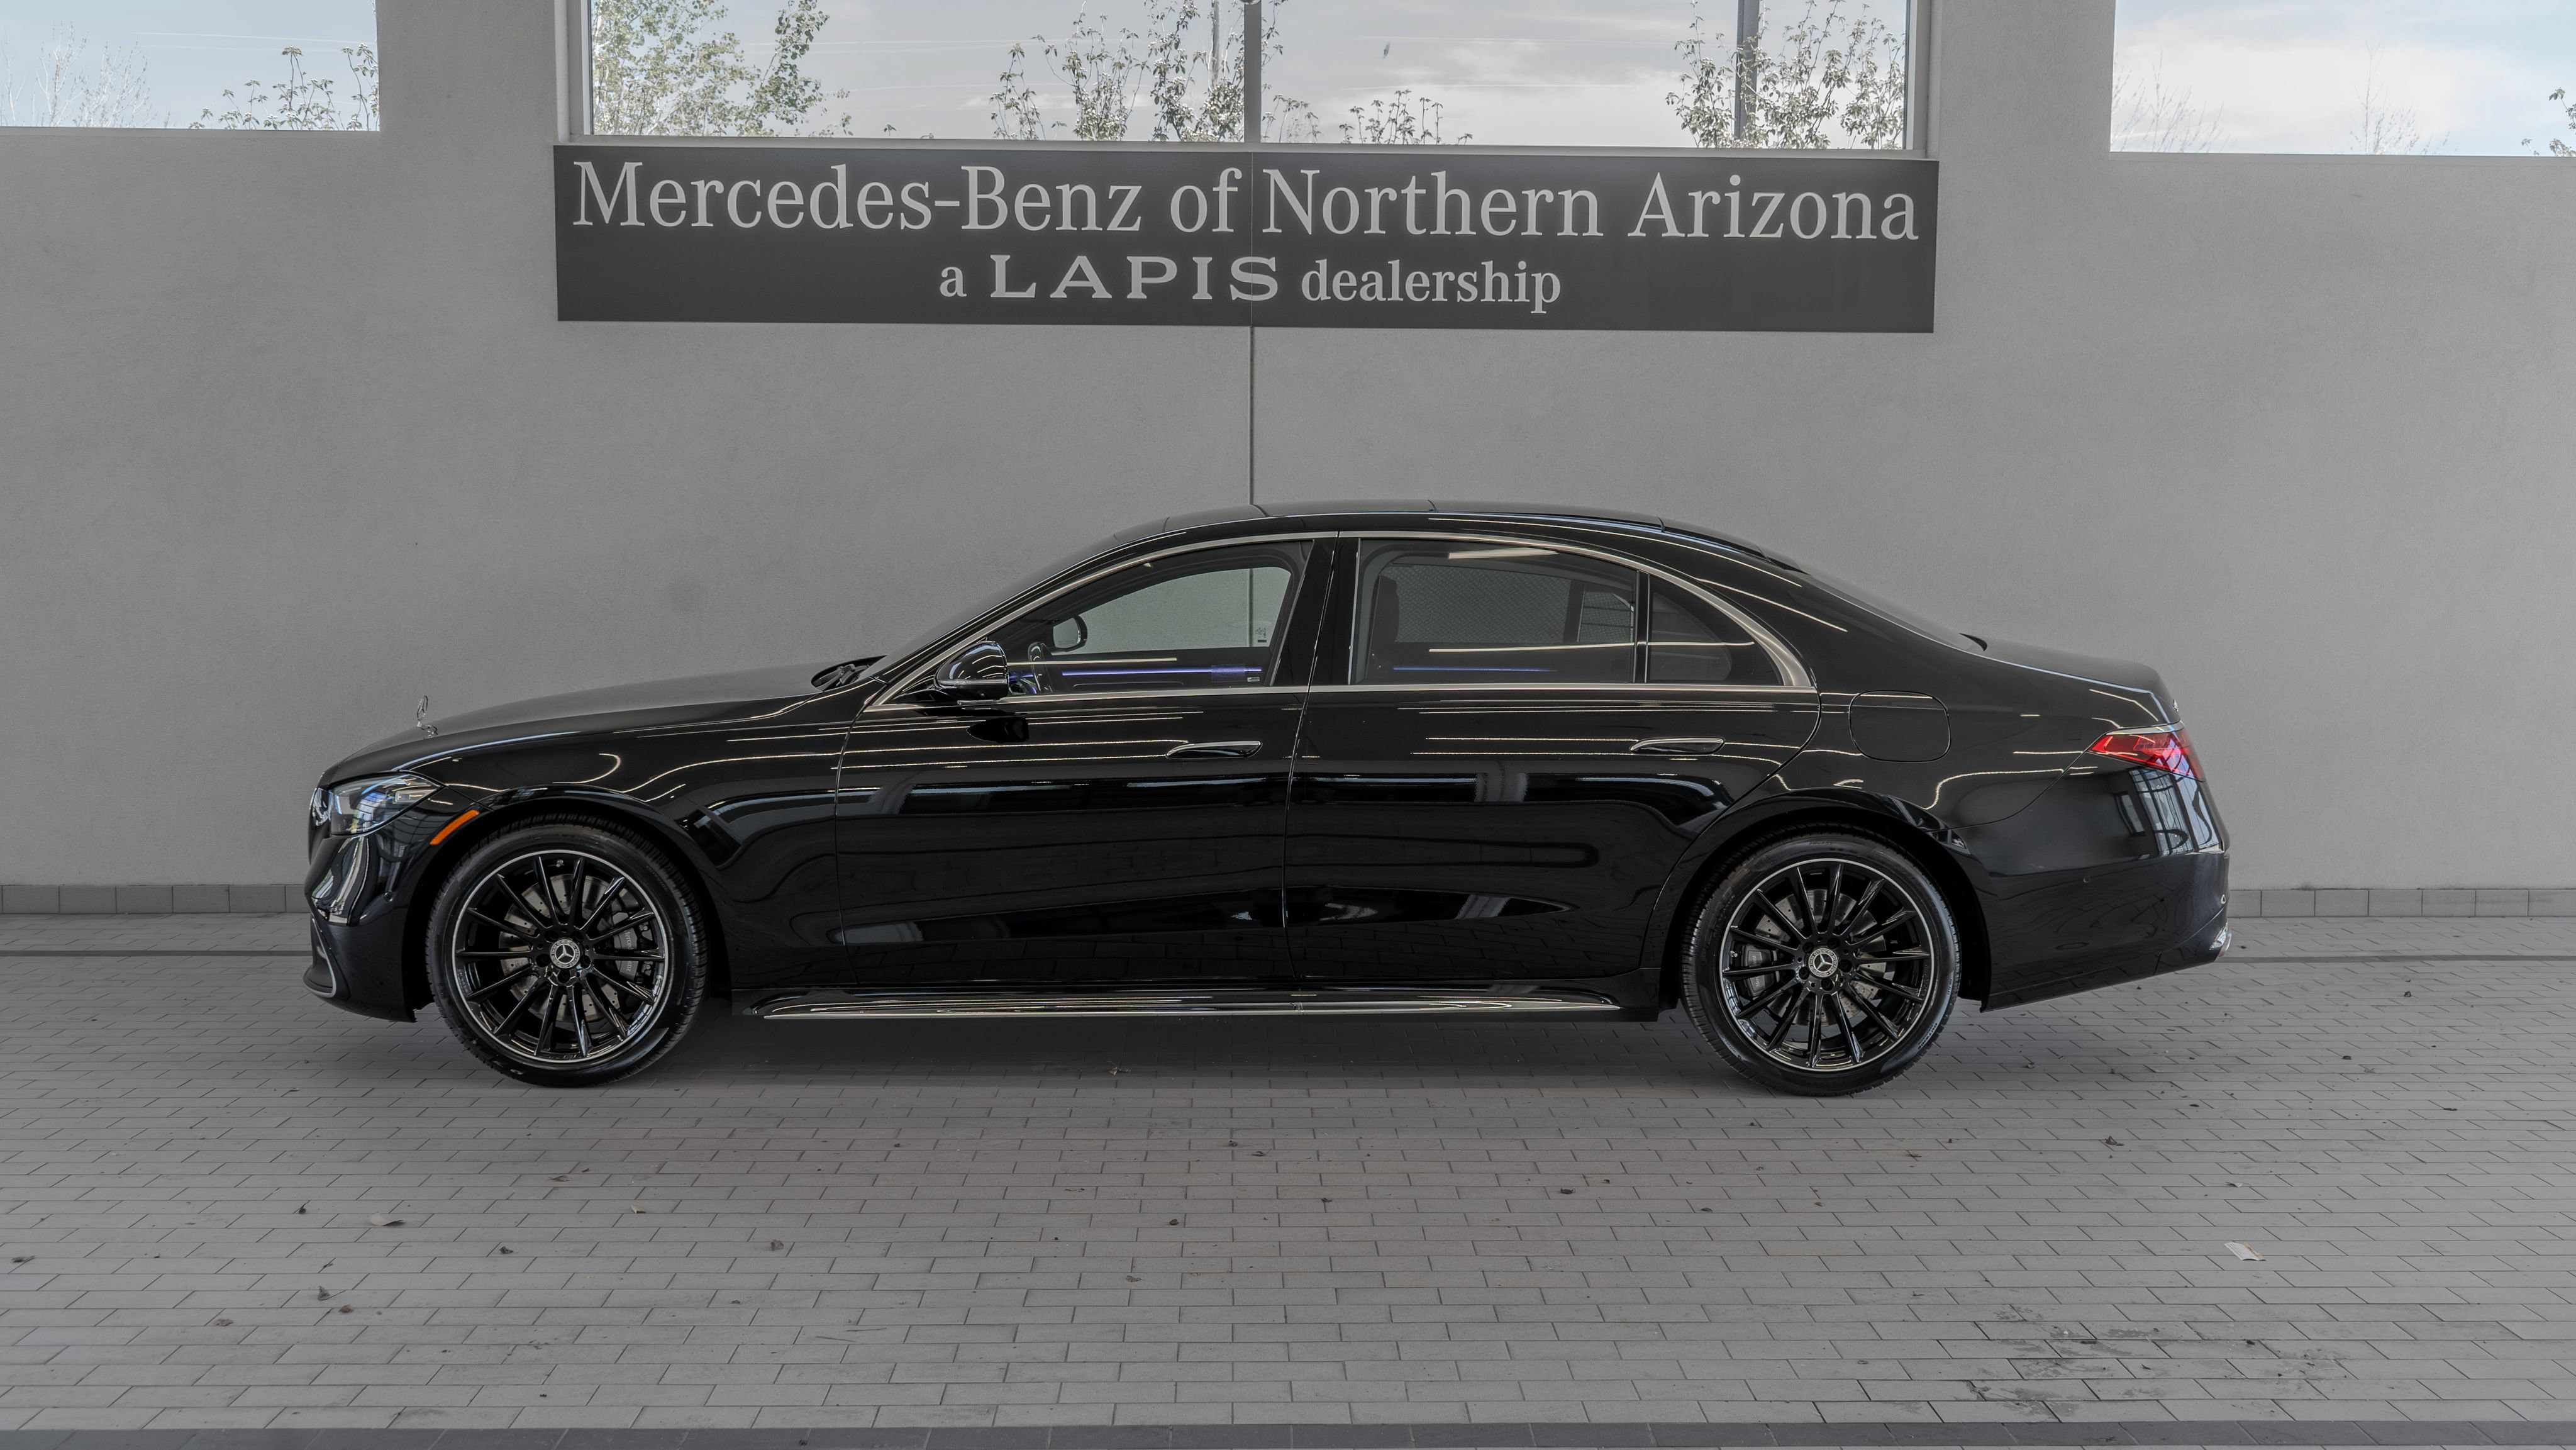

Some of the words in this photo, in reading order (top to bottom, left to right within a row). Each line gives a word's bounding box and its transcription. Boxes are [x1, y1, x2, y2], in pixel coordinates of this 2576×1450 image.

[573, 161, 1143, 231] Mercedes-Benz
[1170, 167, 1243, 233] of
[1262, 169, 1604, 238] Northern
[1627, 171, 1919, 240] Arizona
[940, 266, 968, 298] a
[989, 254, 1278, 301] LAPIS
[1301, 259, 1561, 314] dealership
